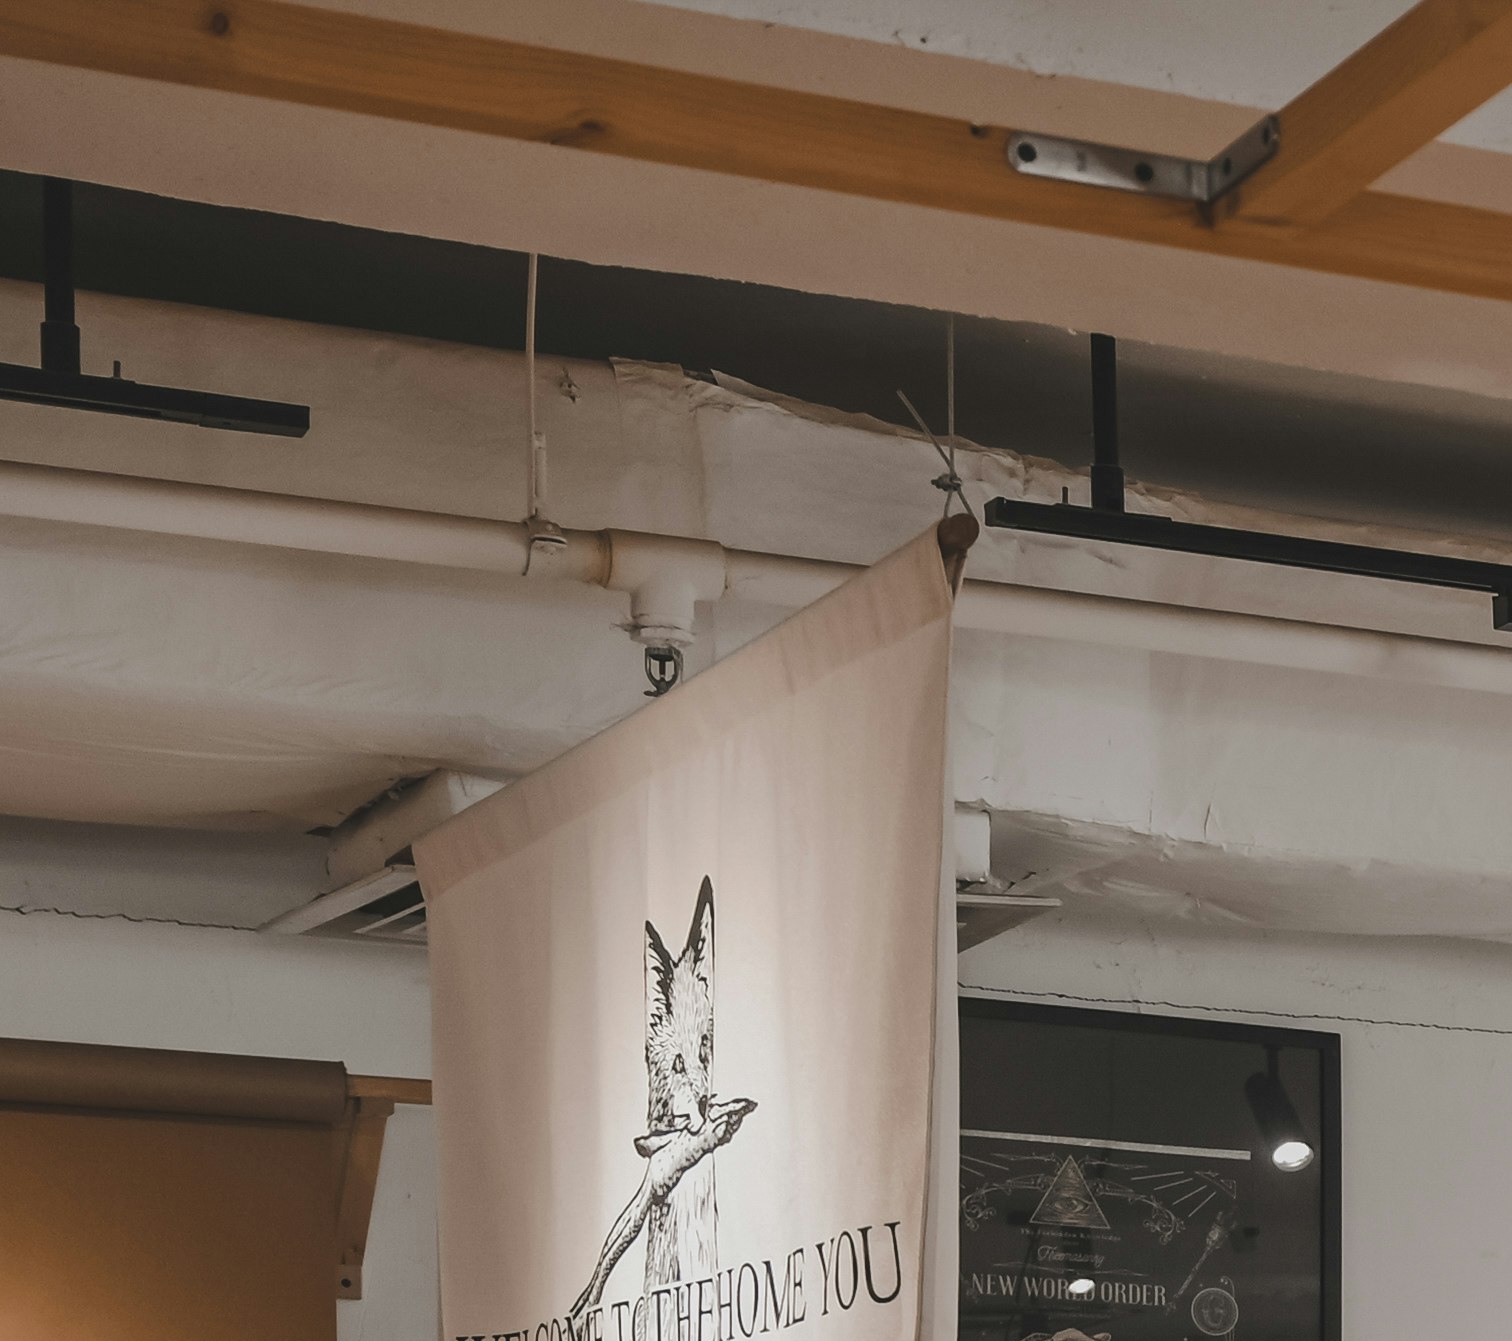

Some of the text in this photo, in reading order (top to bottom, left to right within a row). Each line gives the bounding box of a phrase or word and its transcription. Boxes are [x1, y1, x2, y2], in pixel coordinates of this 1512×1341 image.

[815, 1221, 902, 1317] YOU
[972, 1273, 1017, 1296] NEW
[1101, 1282, 1166, 1306] ORDER
